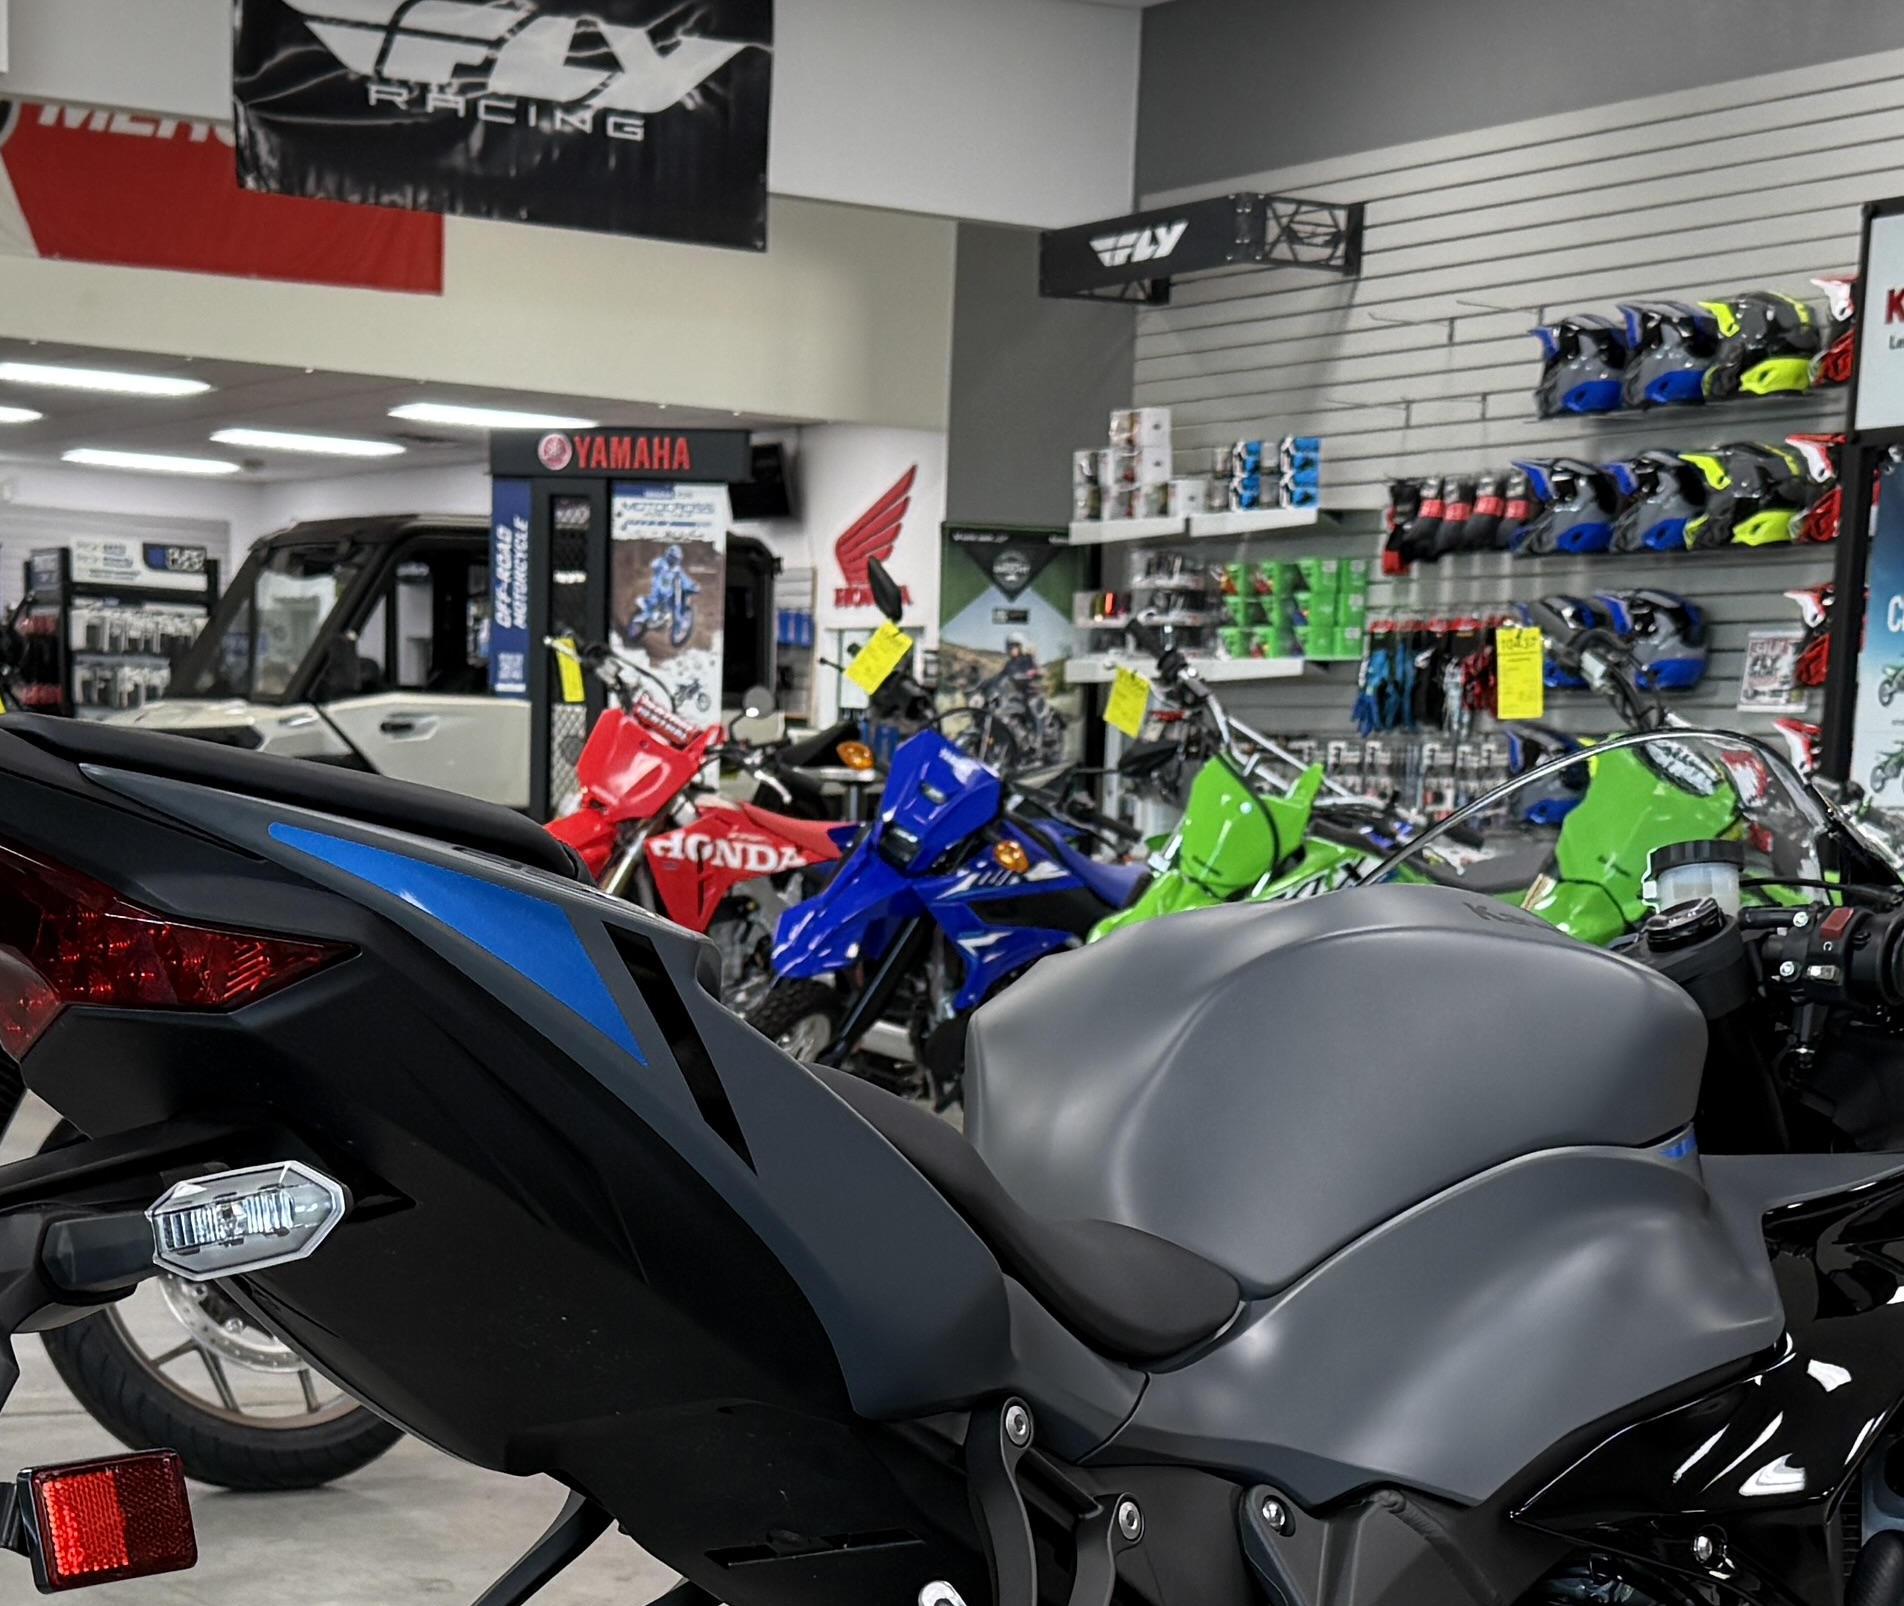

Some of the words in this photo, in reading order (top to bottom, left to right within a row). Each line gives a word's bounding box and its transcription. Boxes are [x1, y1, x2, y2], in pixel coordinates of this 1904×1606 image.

[281, 0, 749, 113] FLY
[366, 82, 646, 141] RACING
[1089, 218, 1189, 267] FLY
[574, 436, 691, 471] YAMAHA
[495, 524, 514, 629] OFF-ROAD
[512, 515, 530, 630] MOTORCYCLE
[650, 828, 809, 874] HONDA
